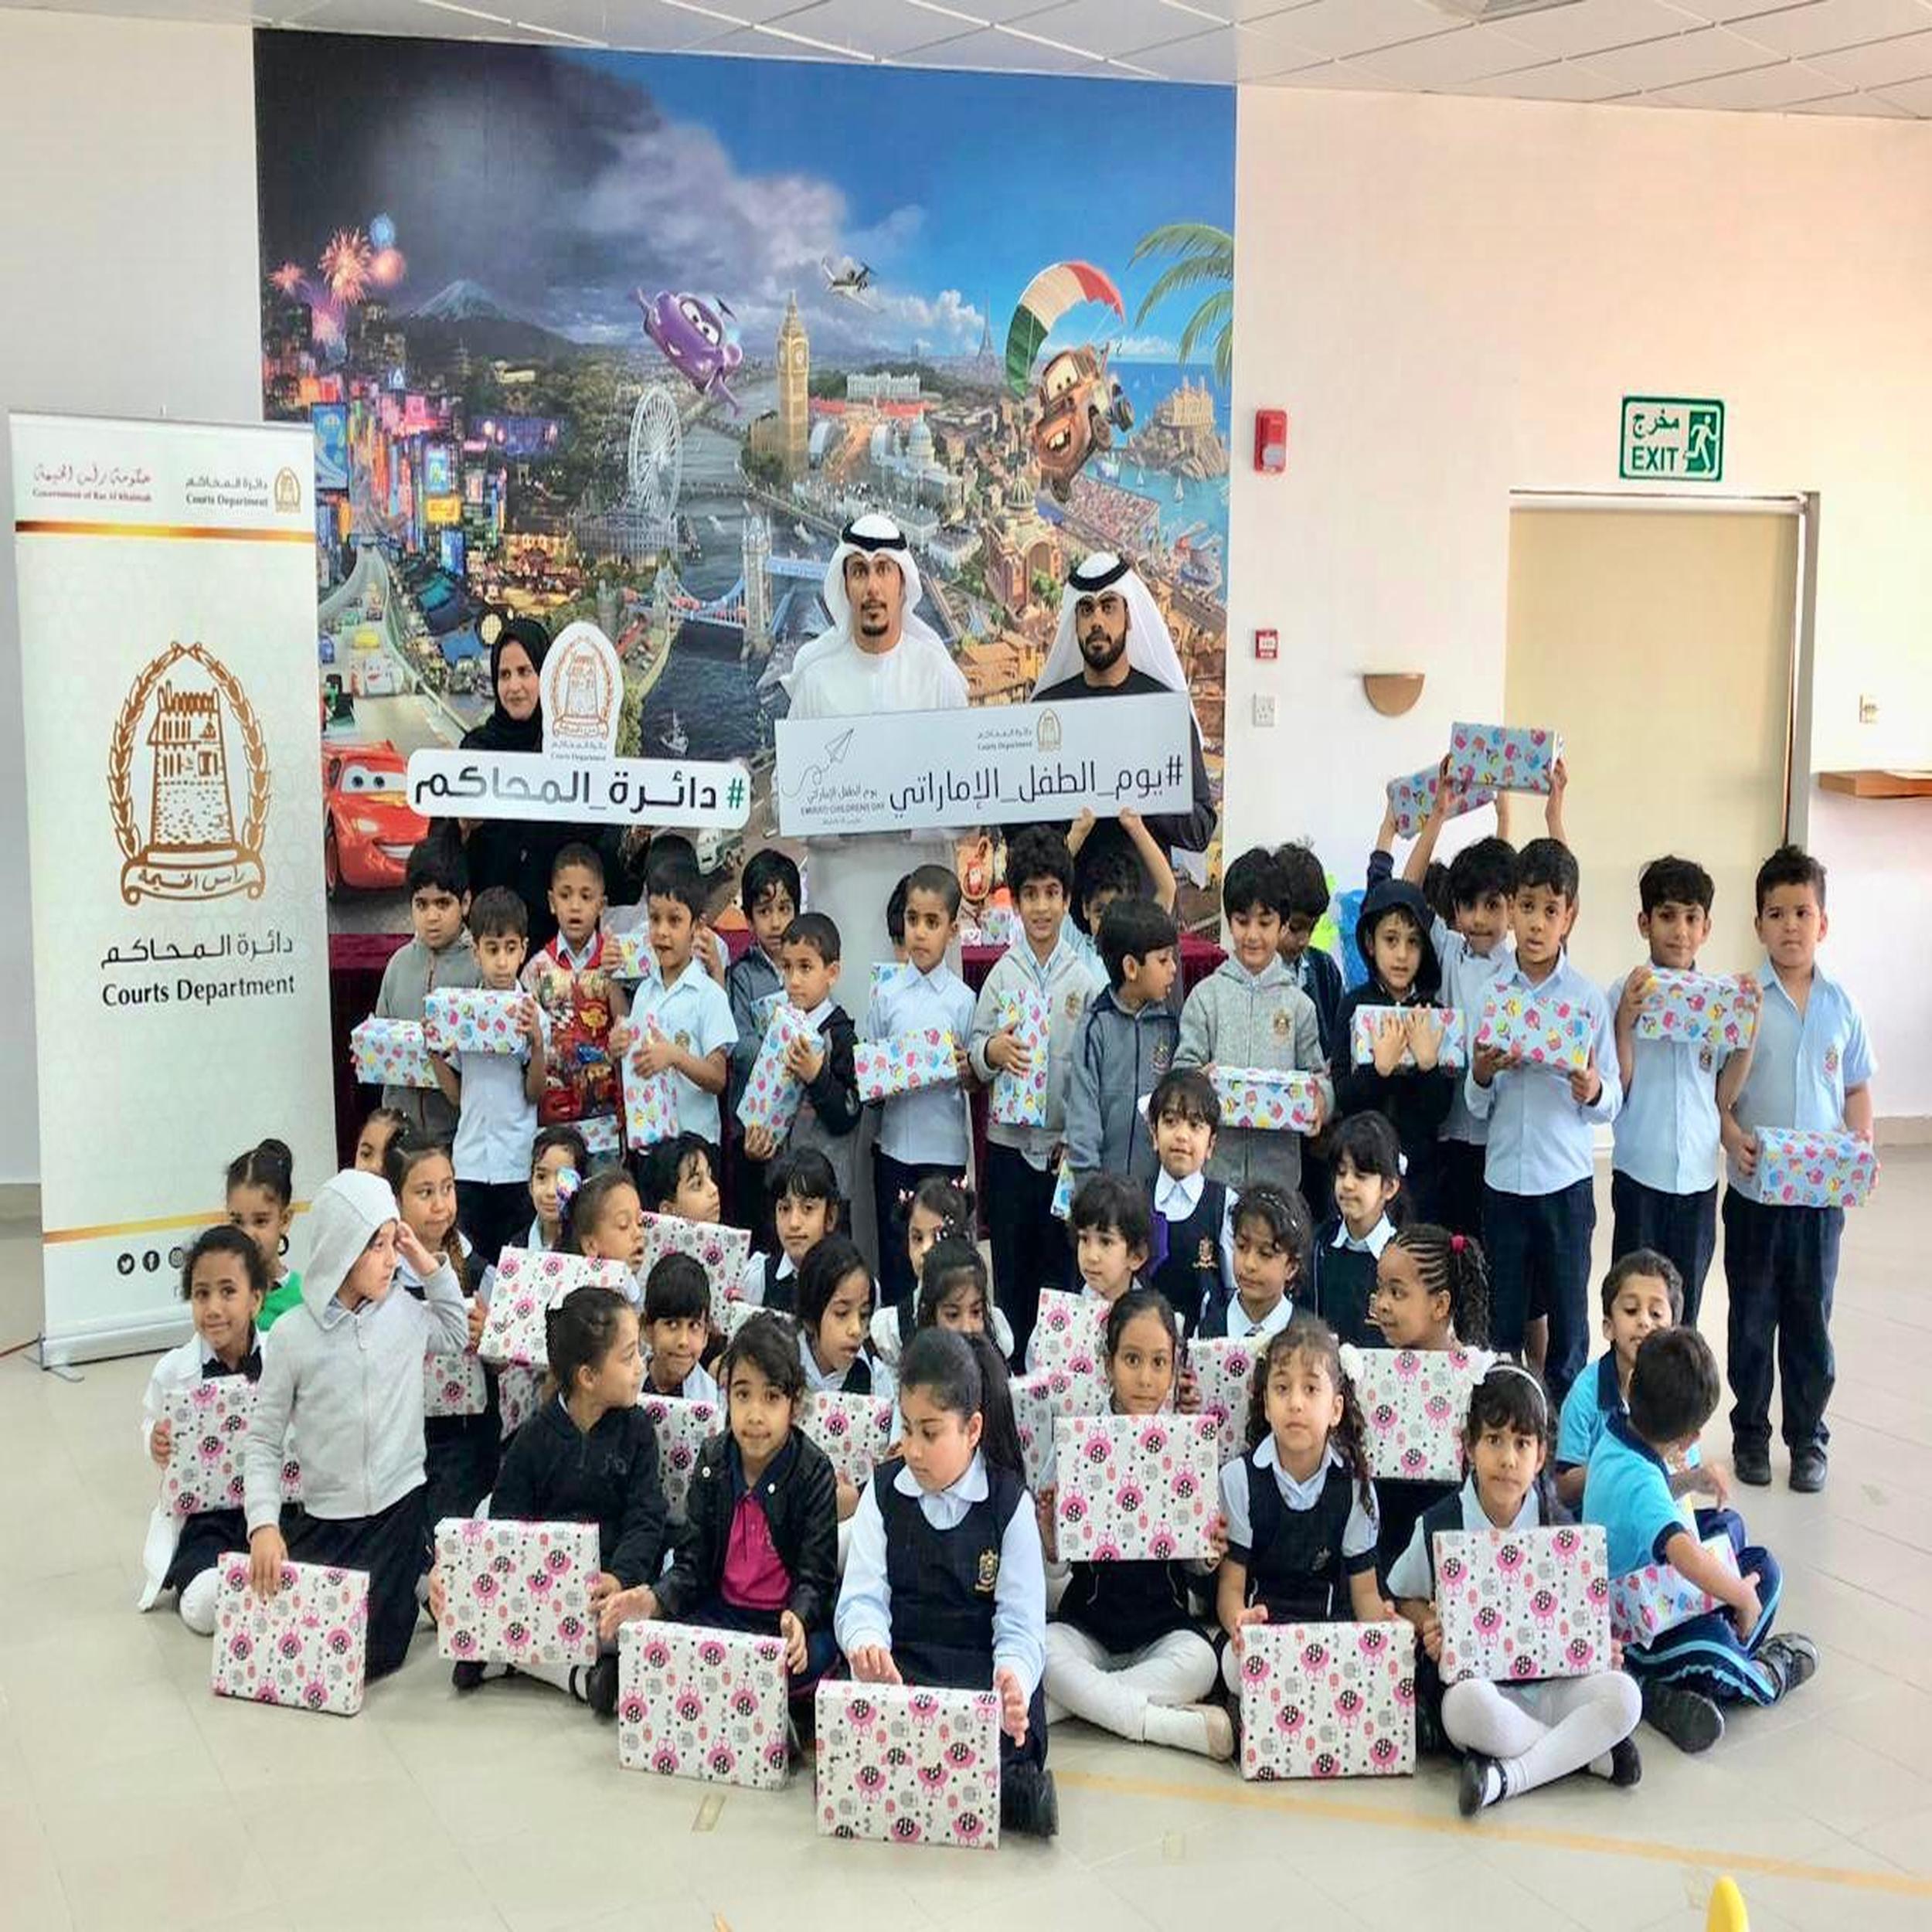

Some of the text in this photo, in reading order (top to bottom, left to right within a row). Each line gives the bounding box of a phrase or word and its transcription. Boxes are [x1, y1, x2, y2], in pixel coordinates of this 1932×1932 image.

[1632, 408, 1679, 440] مخرج
[1631, 445, 1679, 471] EXIT
[185, 494, 268, 509] Courts Department
[202, 865, 245, 892] رأس
[100, 929, 294, 969] دائرة المحاكم
[101, 975, 295, 1005] Courts Department
